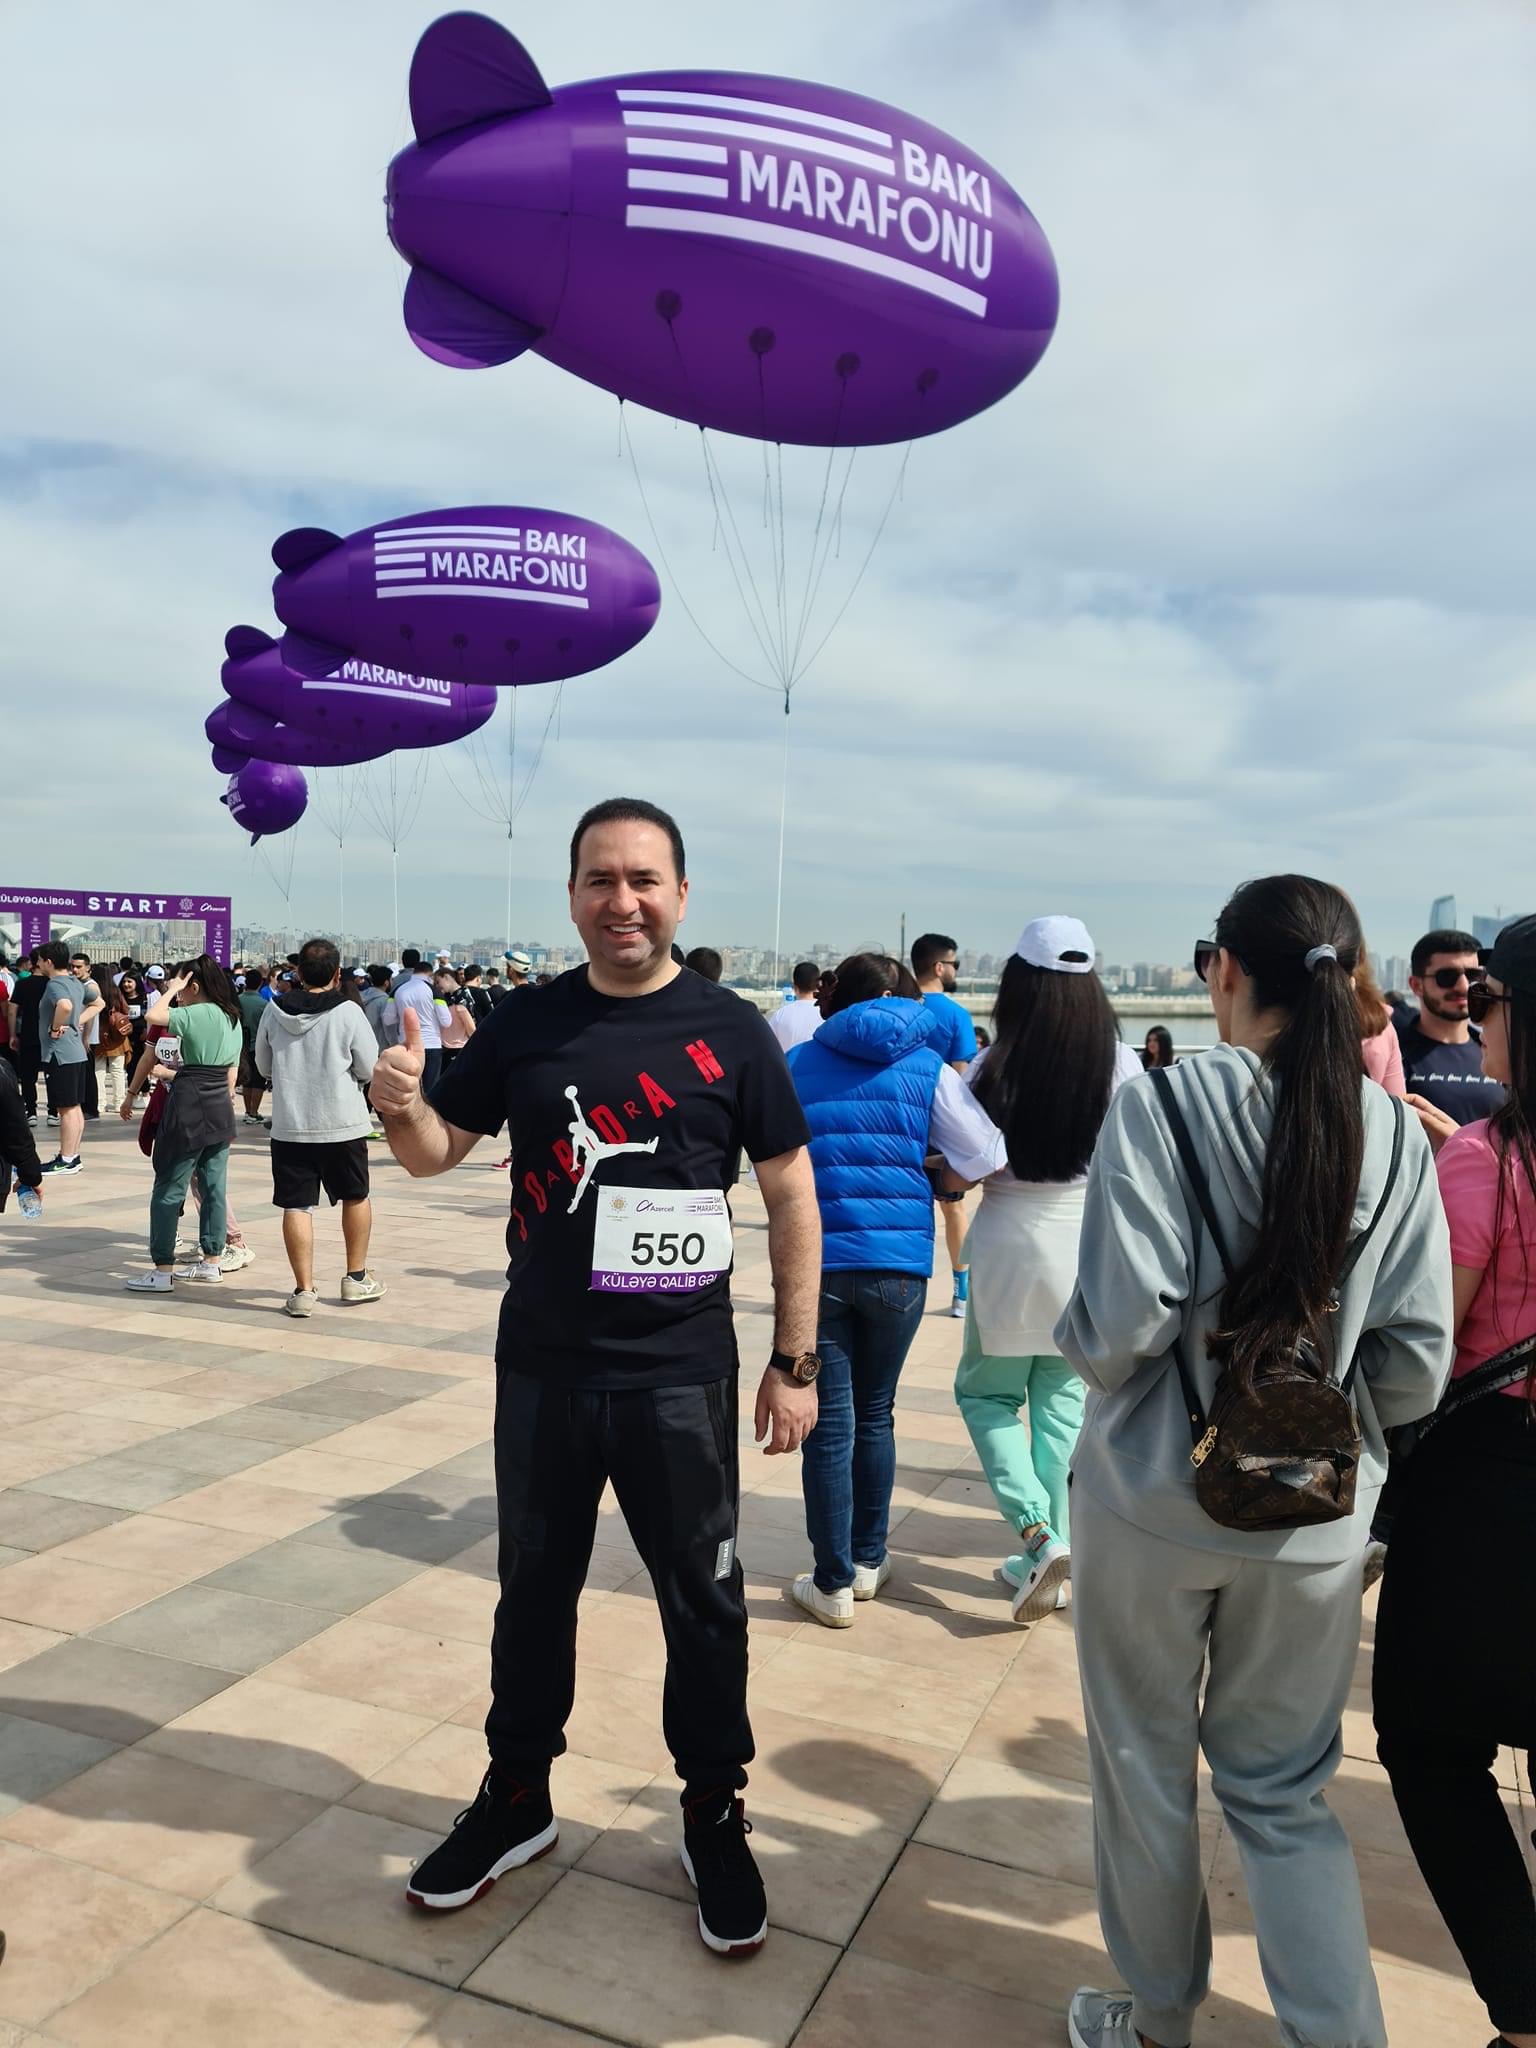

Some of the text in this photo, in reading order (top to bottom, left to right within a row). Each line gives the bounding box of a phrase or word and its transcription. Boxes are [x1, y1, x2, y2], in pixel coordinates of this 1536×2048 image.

[901, 138, 993, 218] BAKI
[739, 149, 993, 280] MARAFONU
[525, 528, 587, 559] BAKI
[431, 551, 588, 591] MARAFONU
[87, 896, 168, 914] START
[630, 1232, 706, 1266] 550
[601, 1272, 658, 1289] KÜLƏYƏ
[659, 1273, 697, 1289] QALİB
